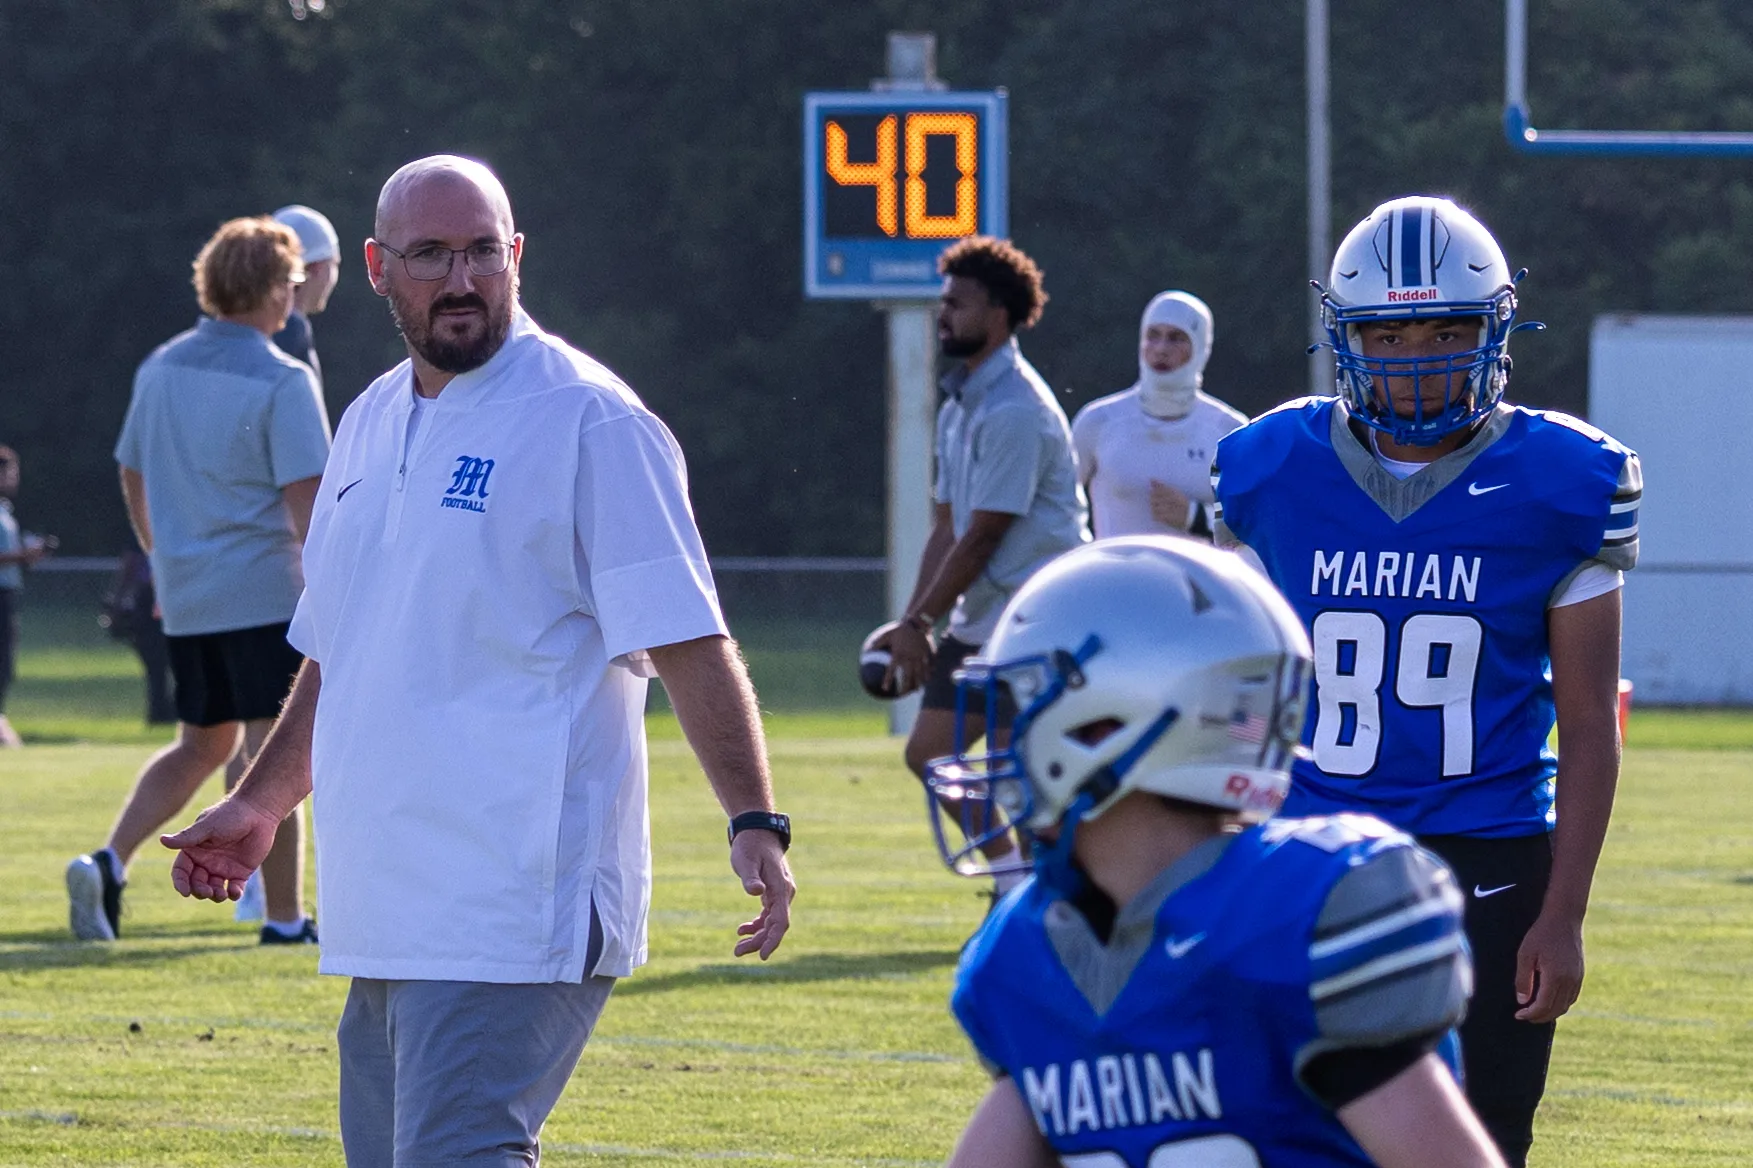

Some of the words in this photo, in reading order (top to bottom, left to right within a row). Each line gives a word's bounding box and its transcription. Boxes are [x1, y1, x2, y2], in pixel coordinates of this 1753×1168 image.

[825, 112, 977, 239] 40
[1387, 288, 1437, 302] Riddell
[440, 497, 486, 513] FOOTBALL
[1311, 550, 1482, 602] MARIAN
[1312, 610, 1484, 777] 89
[1022, 1048, 1222, 1136] MARIAN
